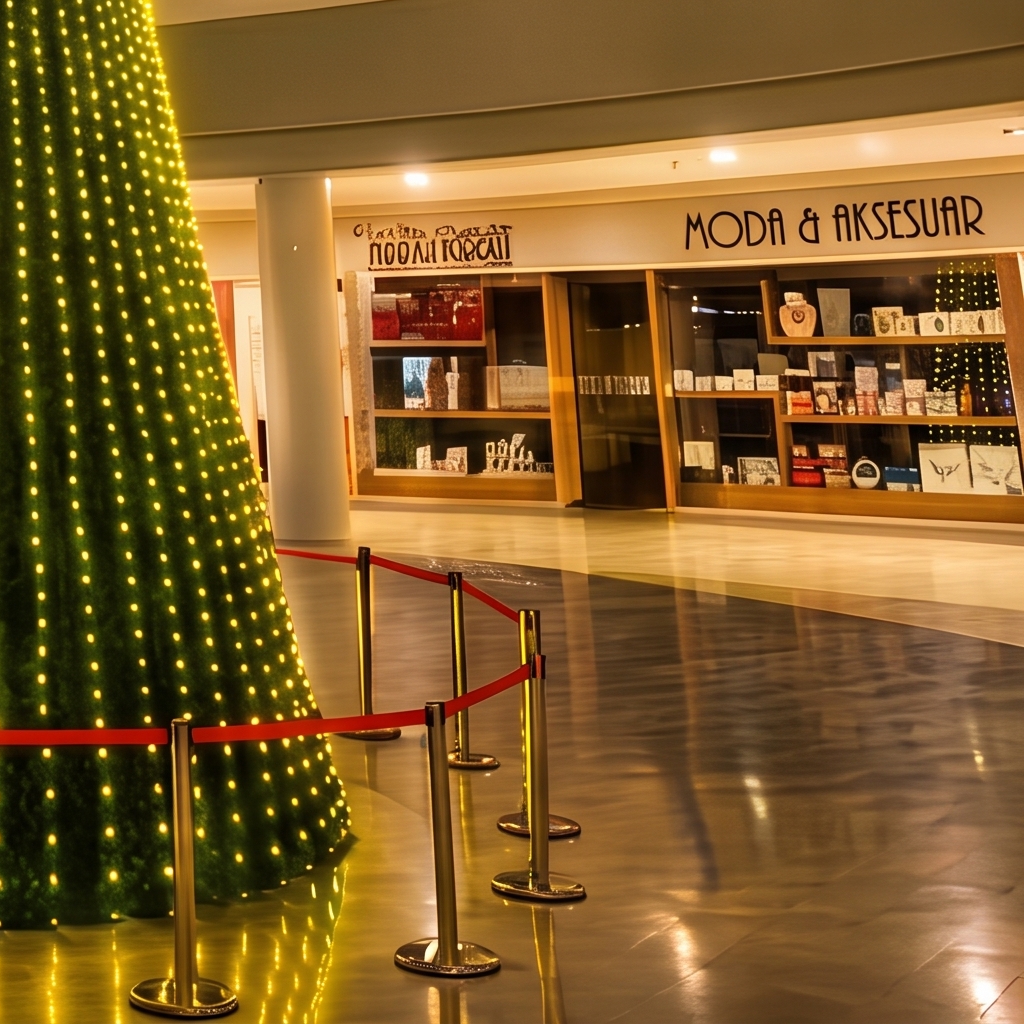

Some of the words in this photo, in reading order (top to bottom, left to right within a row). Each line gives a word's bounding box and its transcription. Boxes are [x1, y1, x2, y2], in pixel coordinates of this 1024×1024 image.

[685, 207, 786, 250] MODA
[798, 207, 820, 244] &
[832, 195, 986, 243] AKSESUAR
